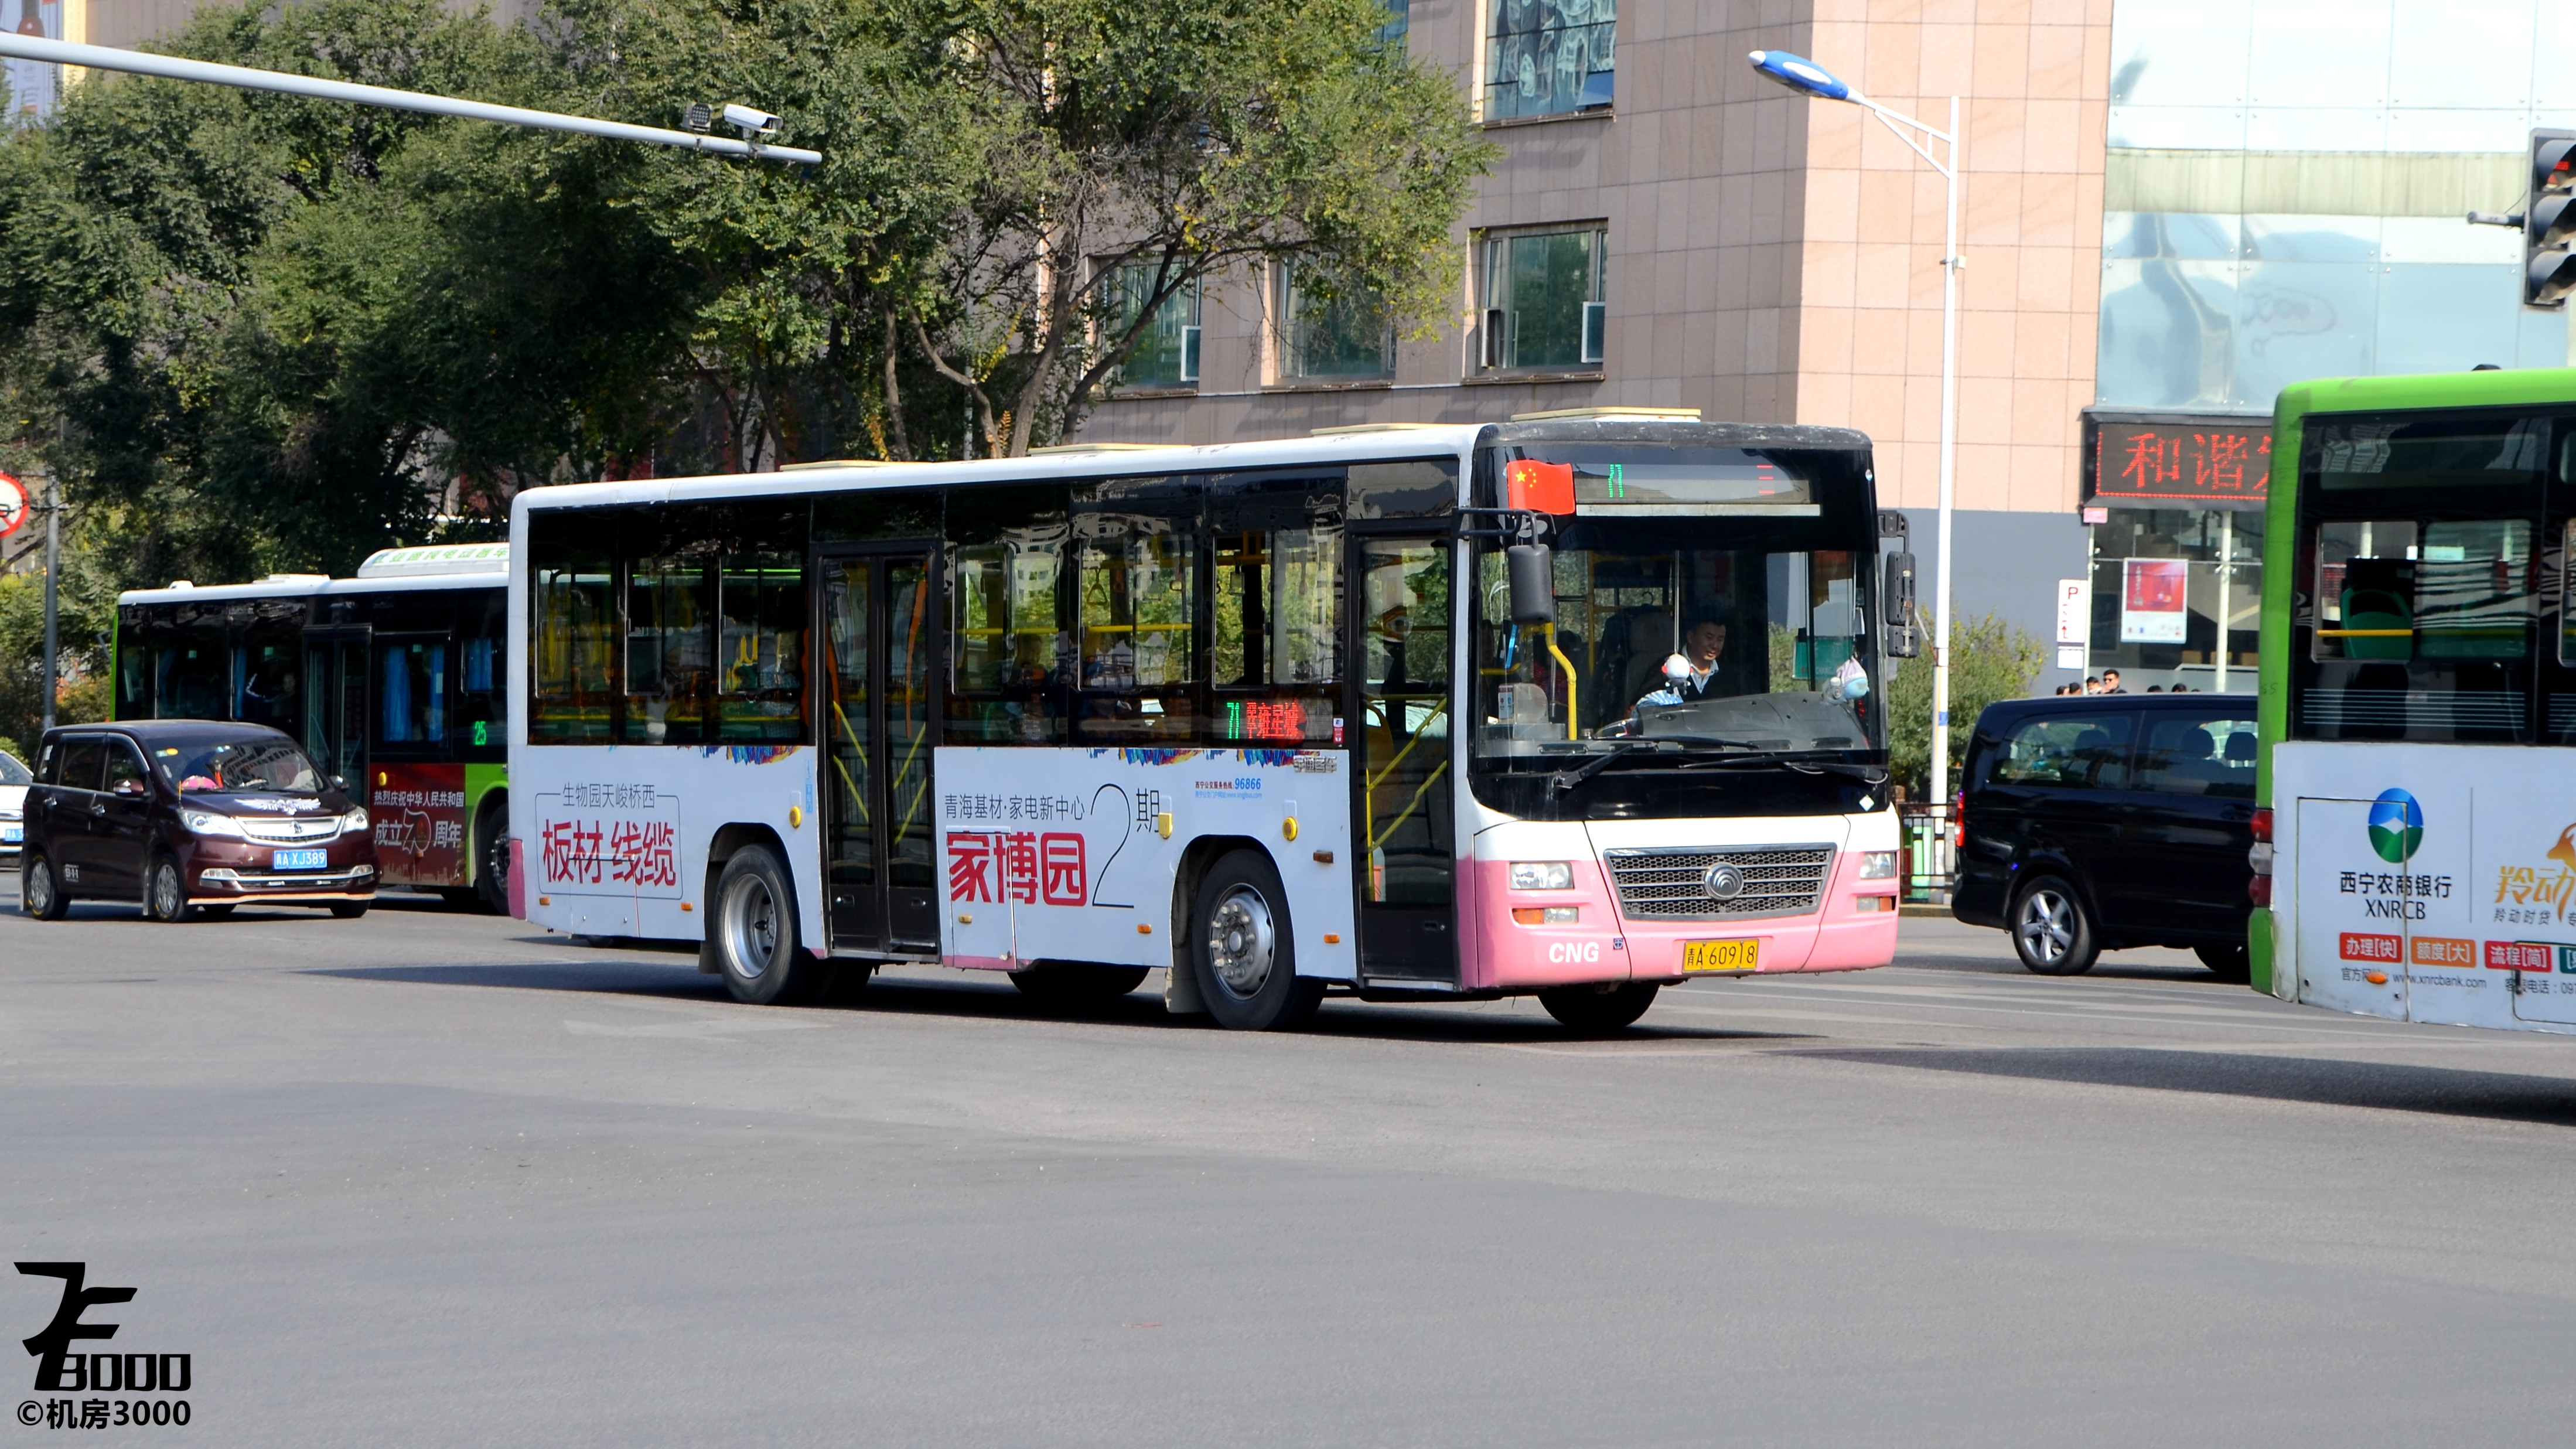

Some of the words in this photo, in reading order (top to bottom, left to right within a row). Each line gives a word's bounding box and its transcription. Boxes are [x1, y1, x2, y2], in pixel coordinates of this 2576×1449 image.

[475, 721, 486, 745] 25
[1294, 755, 1337, 773] 宇通客车
[1234, 778, 1261, 789] 96866
[374, 790, 465, 807] 热烈庆祝中华人民共和国
[562, 782, 655, 809] 生物园天峻桥西
[944, 793, 1084, 821] 青海基材·家电新中心
[374, 808, 462, 854] 成立70周年
[543, 819, 603, 884] 板材
[610, 820, 676, 887] 线缆
[947, 831, 1088, 906] 家博园
[2340, 871, 2452, 898] 西宁农商银行
[2365, 899, 2425, 919] XNRCB
[1549, 942, 1599, 963] CNG
[2346, 937, 2397, 959] 办理[快]
[2417, 942, 2471, 963] 额度[大]
[2490, 946, 2547, 968] 流程[简]
[2393, 973, 2488, 988] www.xnrcbank.com
